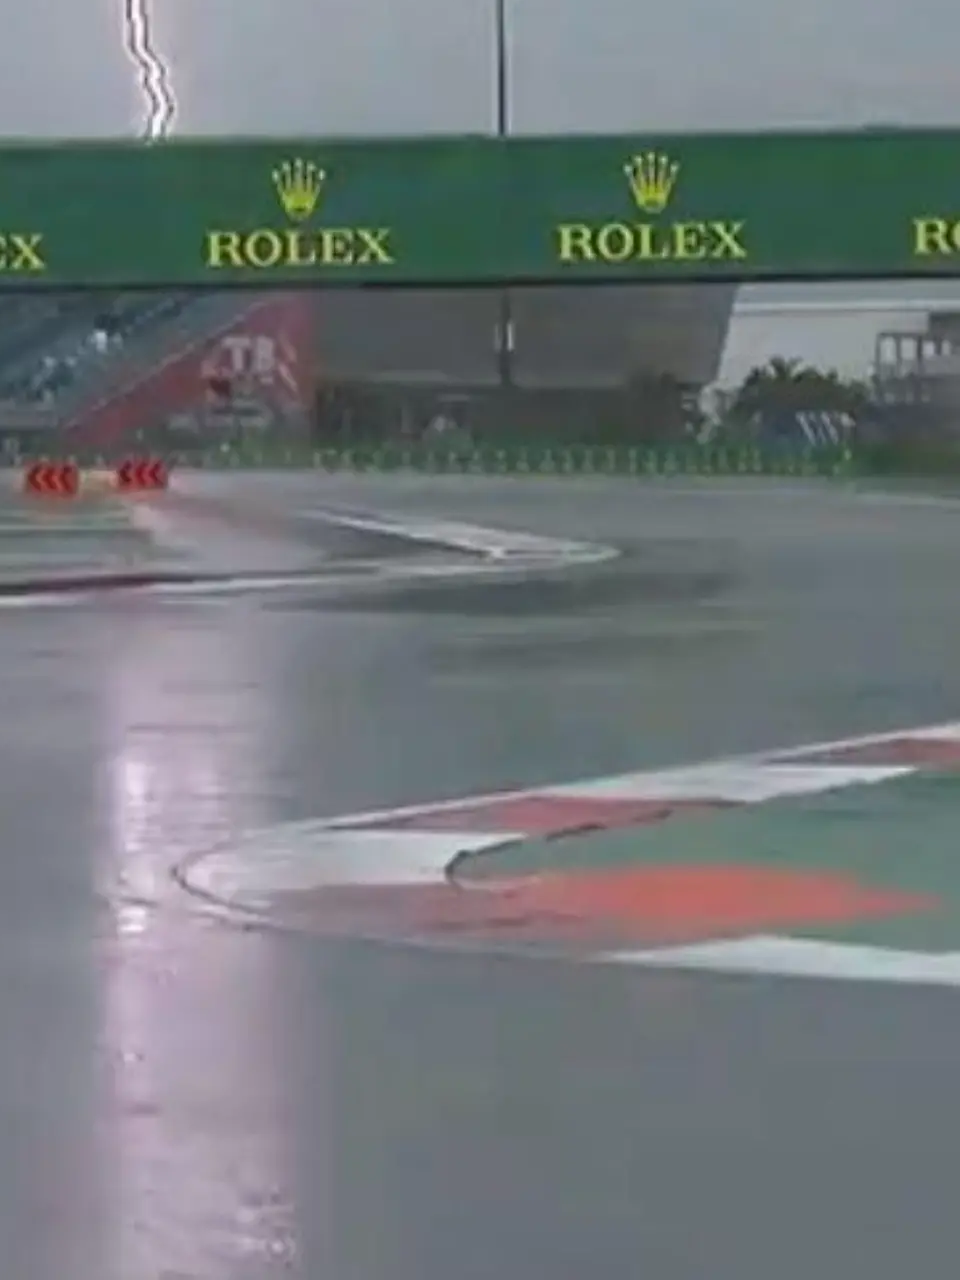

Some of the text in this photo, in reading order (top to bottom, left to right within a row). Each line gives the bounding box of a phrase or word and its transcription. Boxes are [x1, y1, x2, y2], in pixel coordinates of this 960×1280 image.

[207, 228, 395, 267] ROLEX
[558, 222, 746, 261] ROLEX
[913, 218, 960, 255] R
